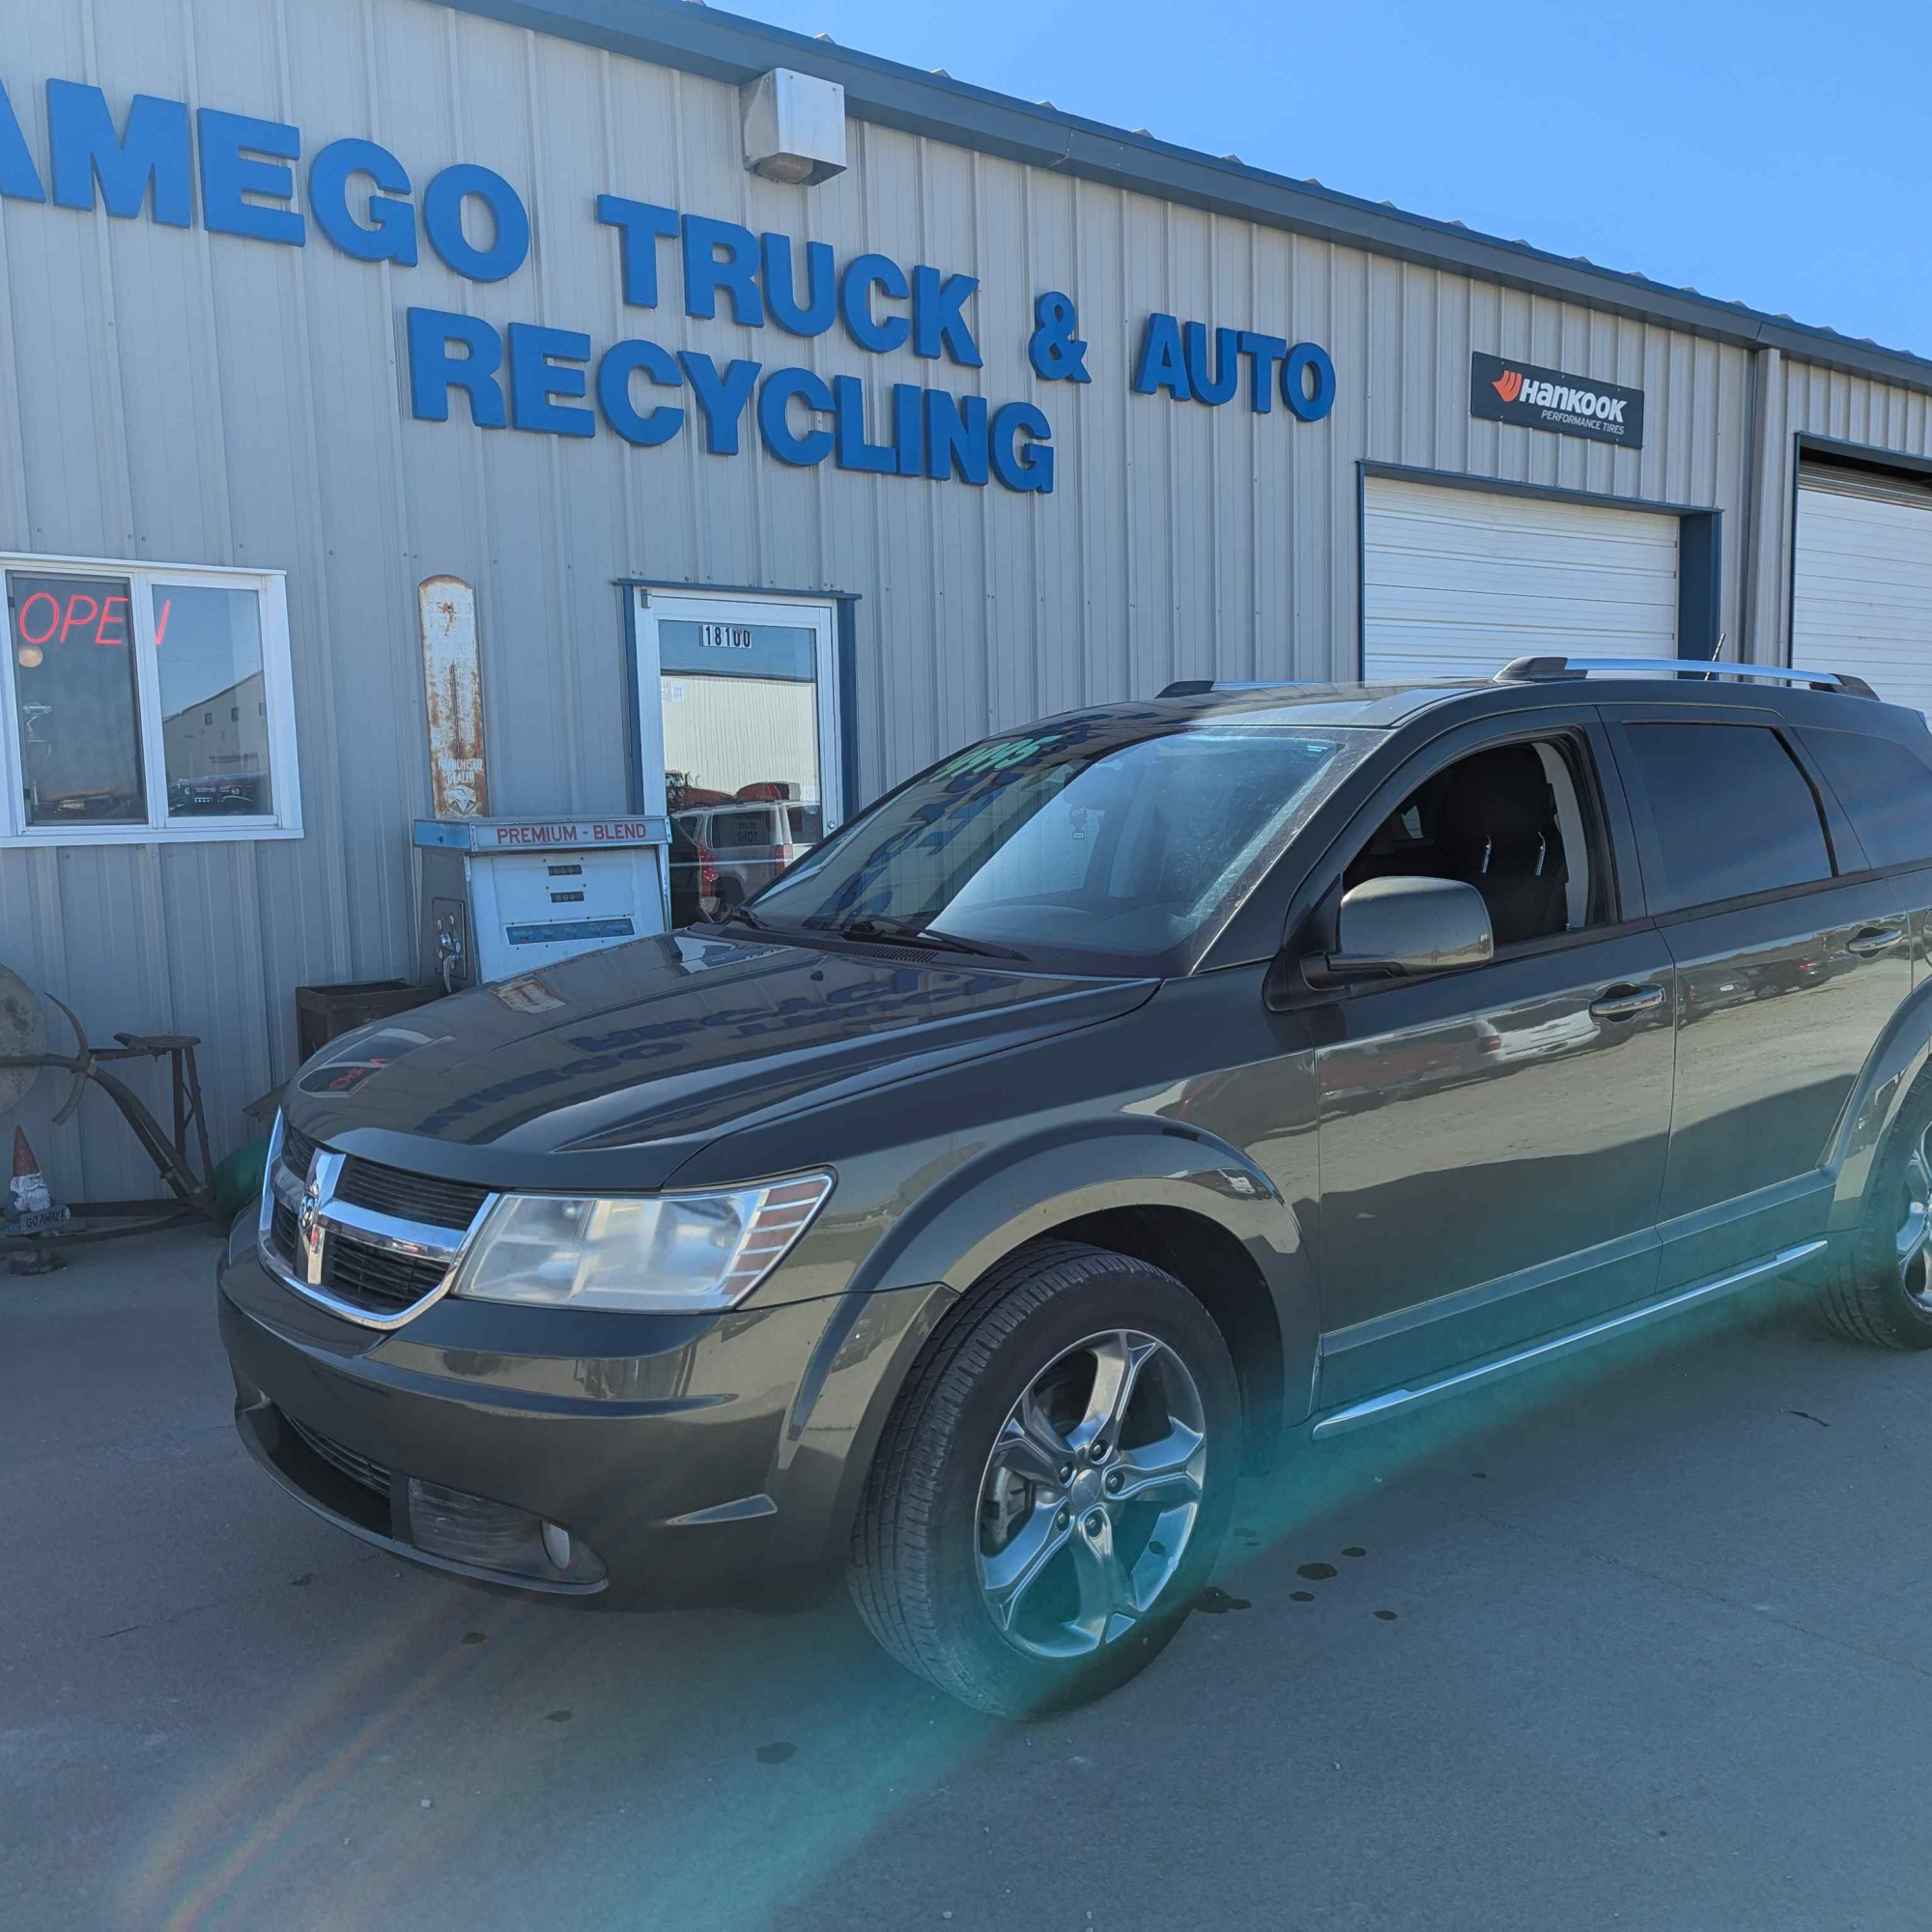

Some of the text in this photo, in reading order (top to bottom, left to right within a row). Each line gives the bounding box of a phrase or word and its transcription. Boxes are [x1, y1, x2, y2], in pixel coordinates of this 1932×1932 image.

[598, 194, 982, 368] TRUCK
[1029, 292, 1092, 384] &
[1135, 313, 1336, 421] AUTO
[407, 306, 1054, 494] RECYCLING
[1541, 410, 1624, 435] PERFORMANCE TIRES
[705, 626, 751, 648] 18100
[497, 825, 577, 844] PREMIUM
[593, 823, 646, 840] BLEND
[25, 1208, 64, 1227] GO AWAY!
